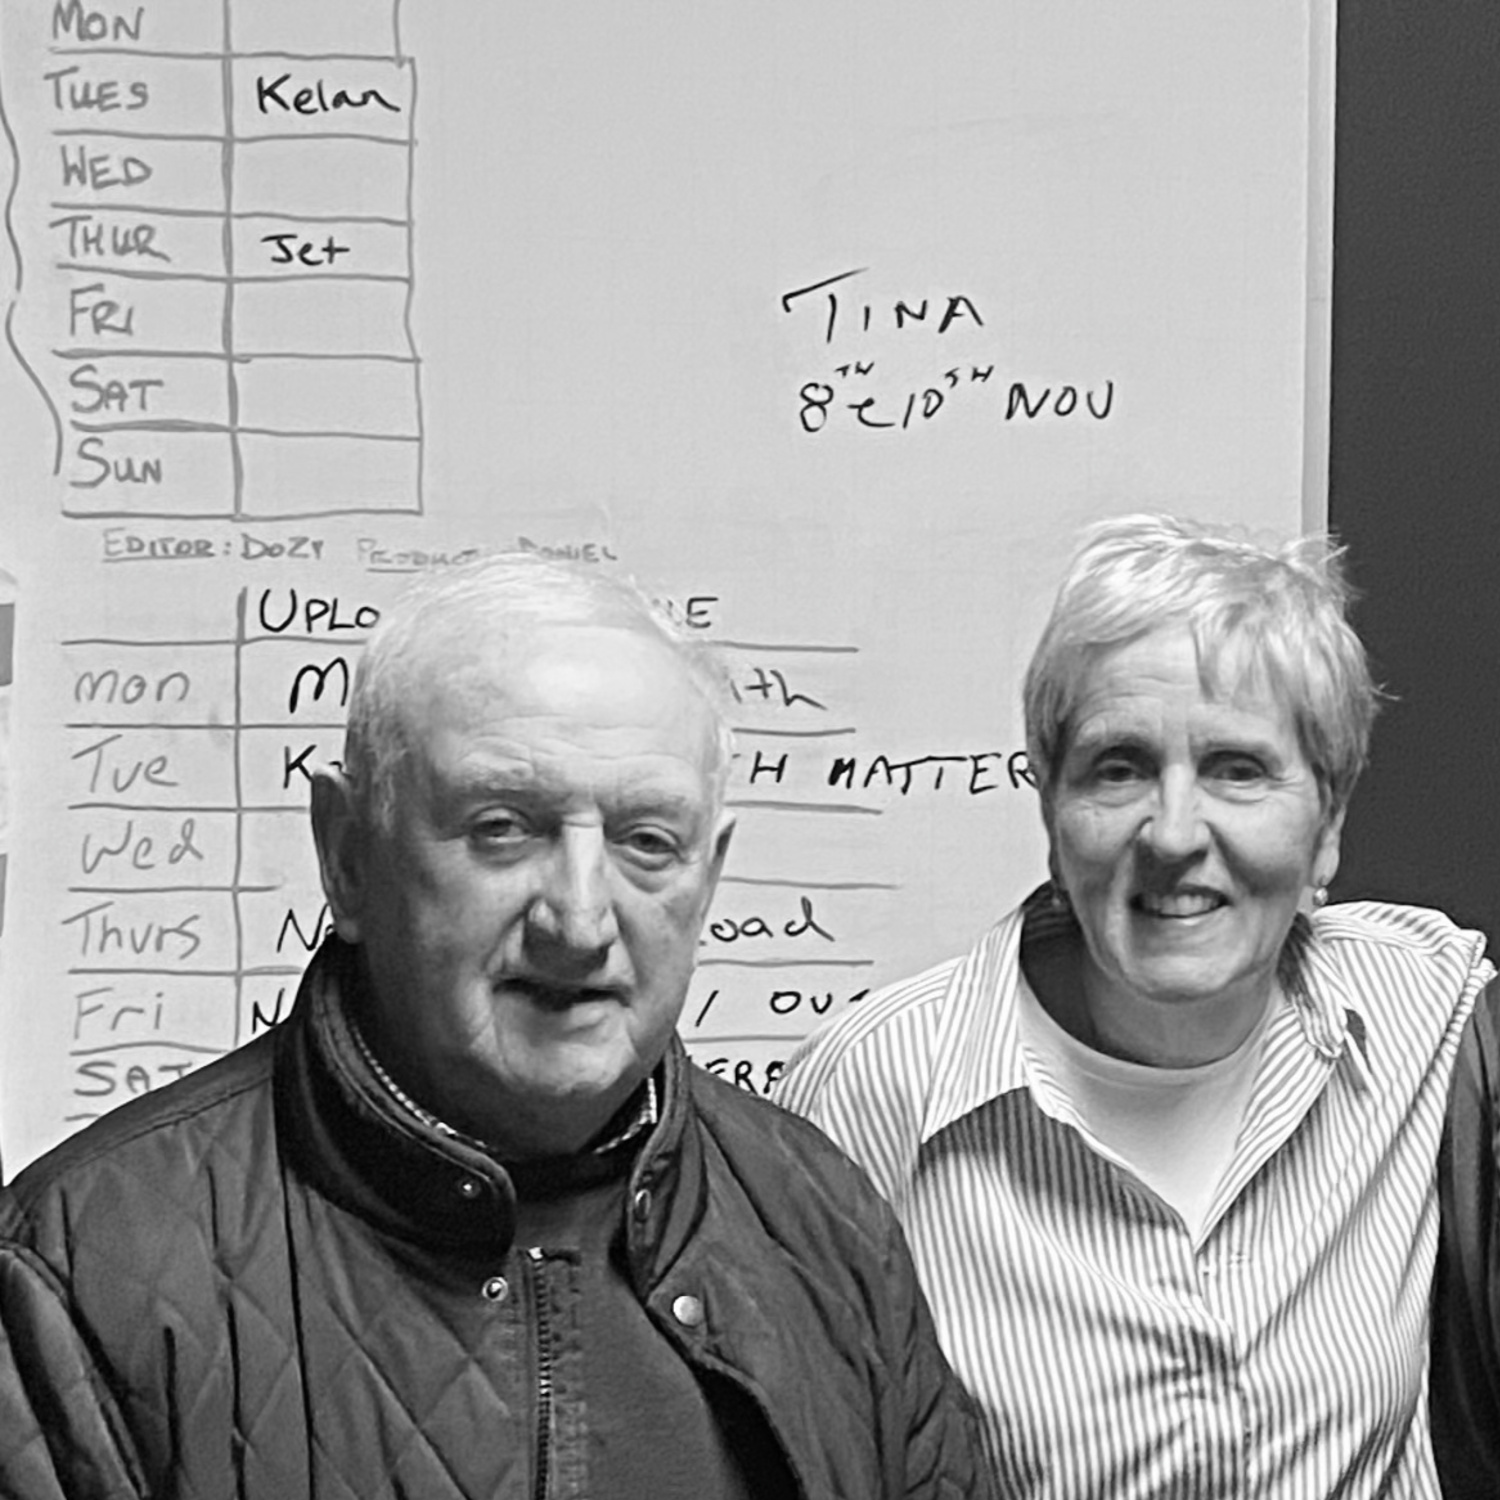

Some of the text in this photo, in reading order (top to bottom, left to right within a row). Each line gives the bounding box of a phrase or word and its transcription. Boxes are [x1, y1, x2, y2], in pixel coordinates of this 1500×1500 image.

[52, 0, 144, 40] MON
[44, 66, 148, 111] TUES
[61, 145, 152, 189] WED
[49, 215, 171, 262] THUR
[70, 284, 133, 336] FRI
[782, 267, 984, 343] TINA
[69, 363, 164, 413] SAT
[259, 588, 381, 632] UPLO
[72, 733, 179, 794] Tue
[81, 817, 204, 874] Wed
[62, 901, 201, 960] Thurs
[73, 987, 165, 1041] Fri
